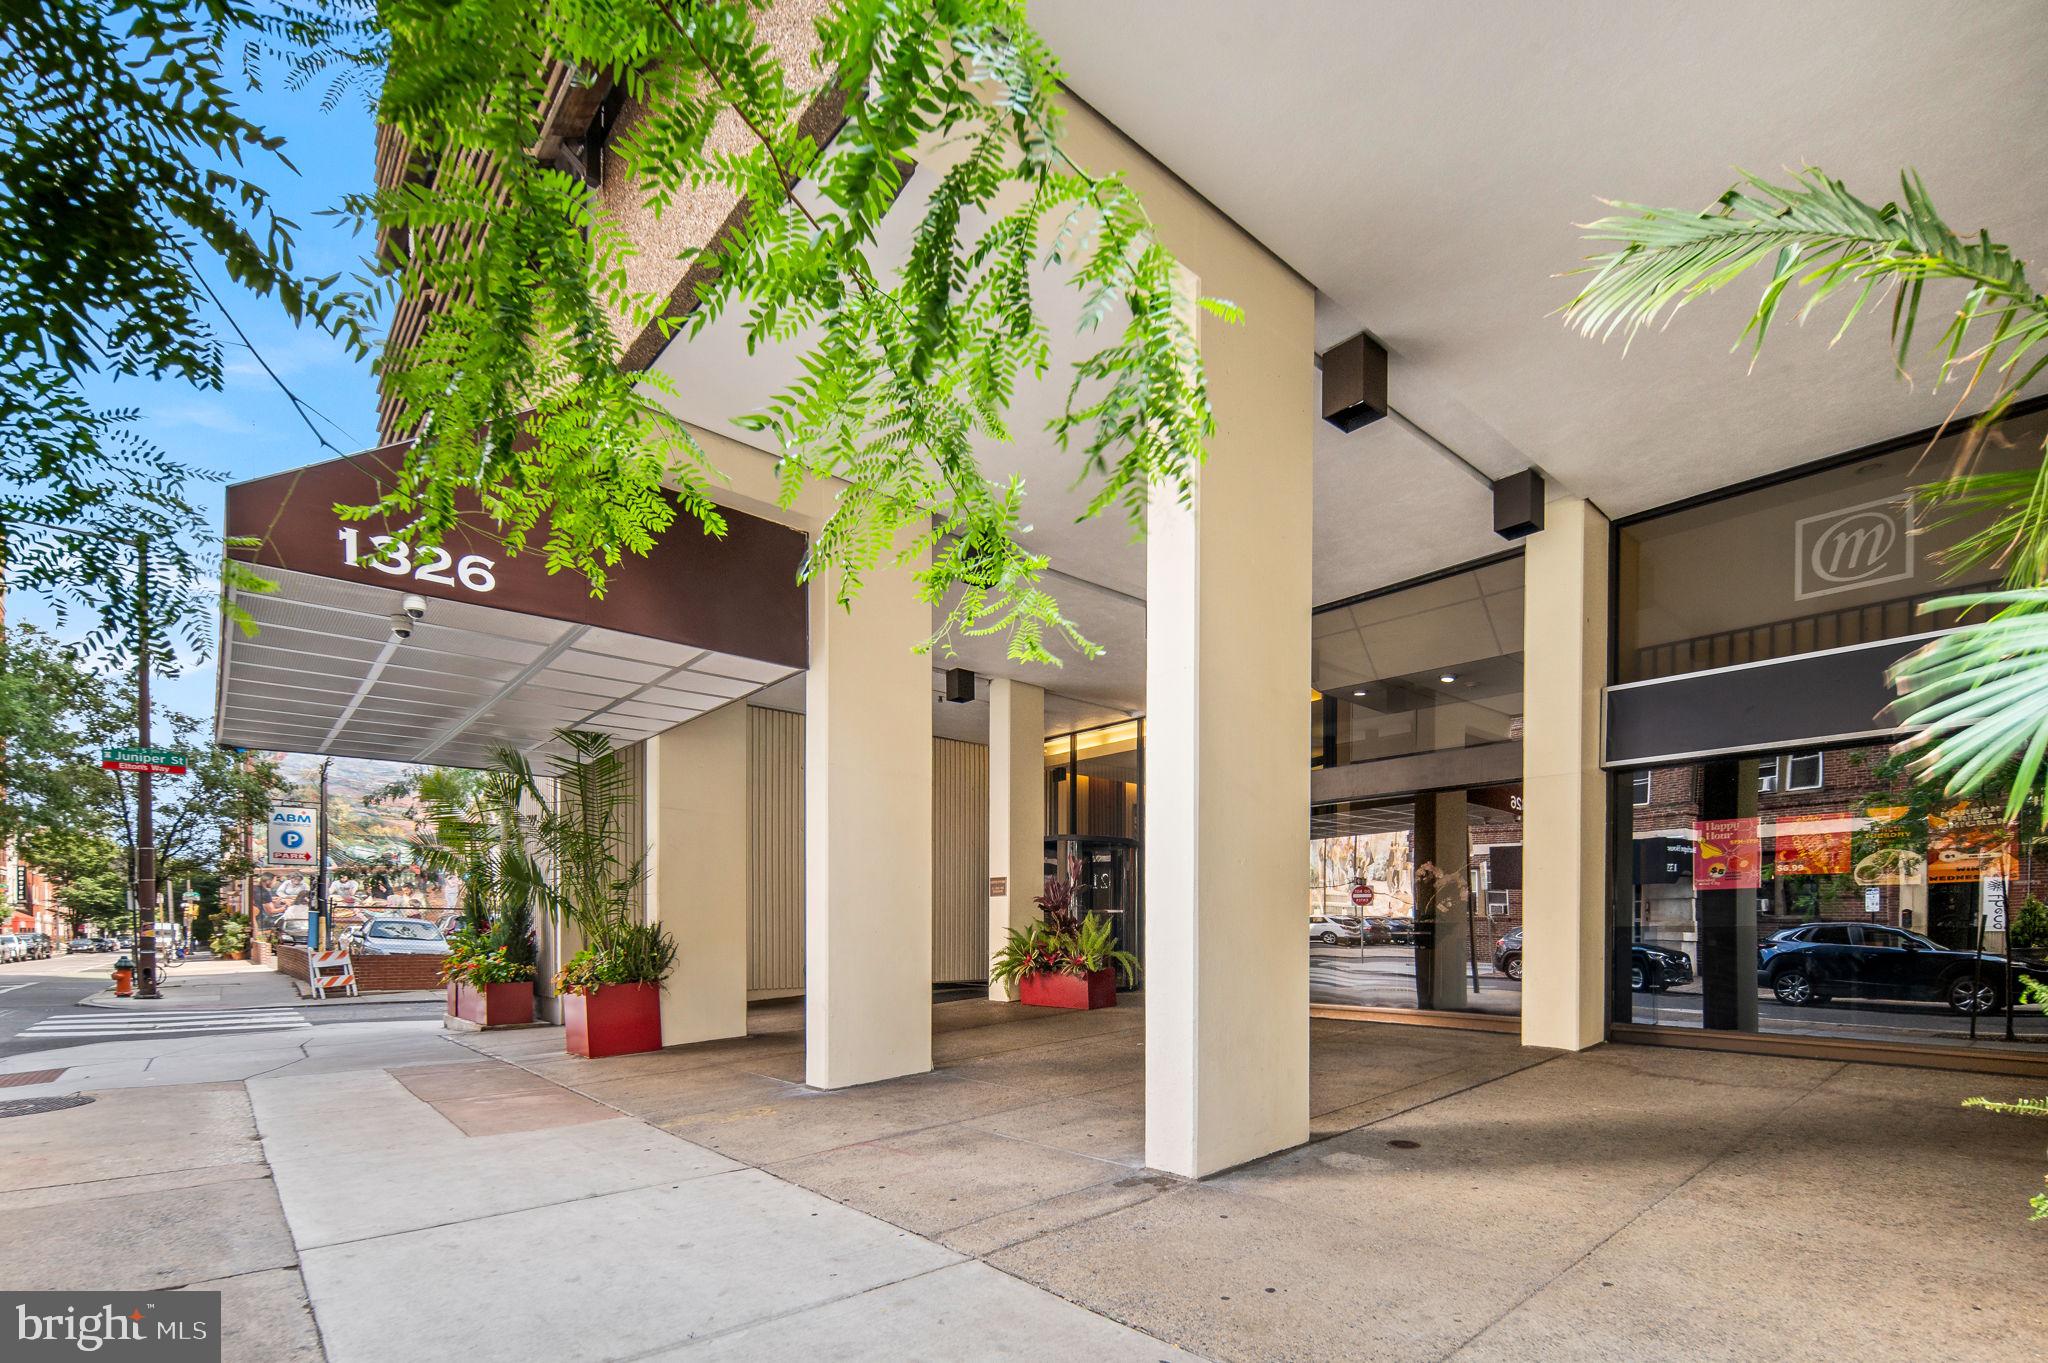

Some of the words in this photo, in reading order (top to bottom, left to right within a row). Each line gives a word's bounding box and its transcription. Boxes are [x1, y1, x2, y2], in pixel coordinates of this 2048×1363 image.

[338, 527, 496, 592] 1326
[115, 752, 166, 764] Juniper
[171, 756, 185, 765] St
[151, 764, 170, 773] Way
[273, 813, 312, 823] ABM
[1705, 821, 1740, 832] Happy
[287, 833, 299, 846] P
[1705, 831, 1734, 840] Hour
[1776, 864, 1804, 872] $6.99
